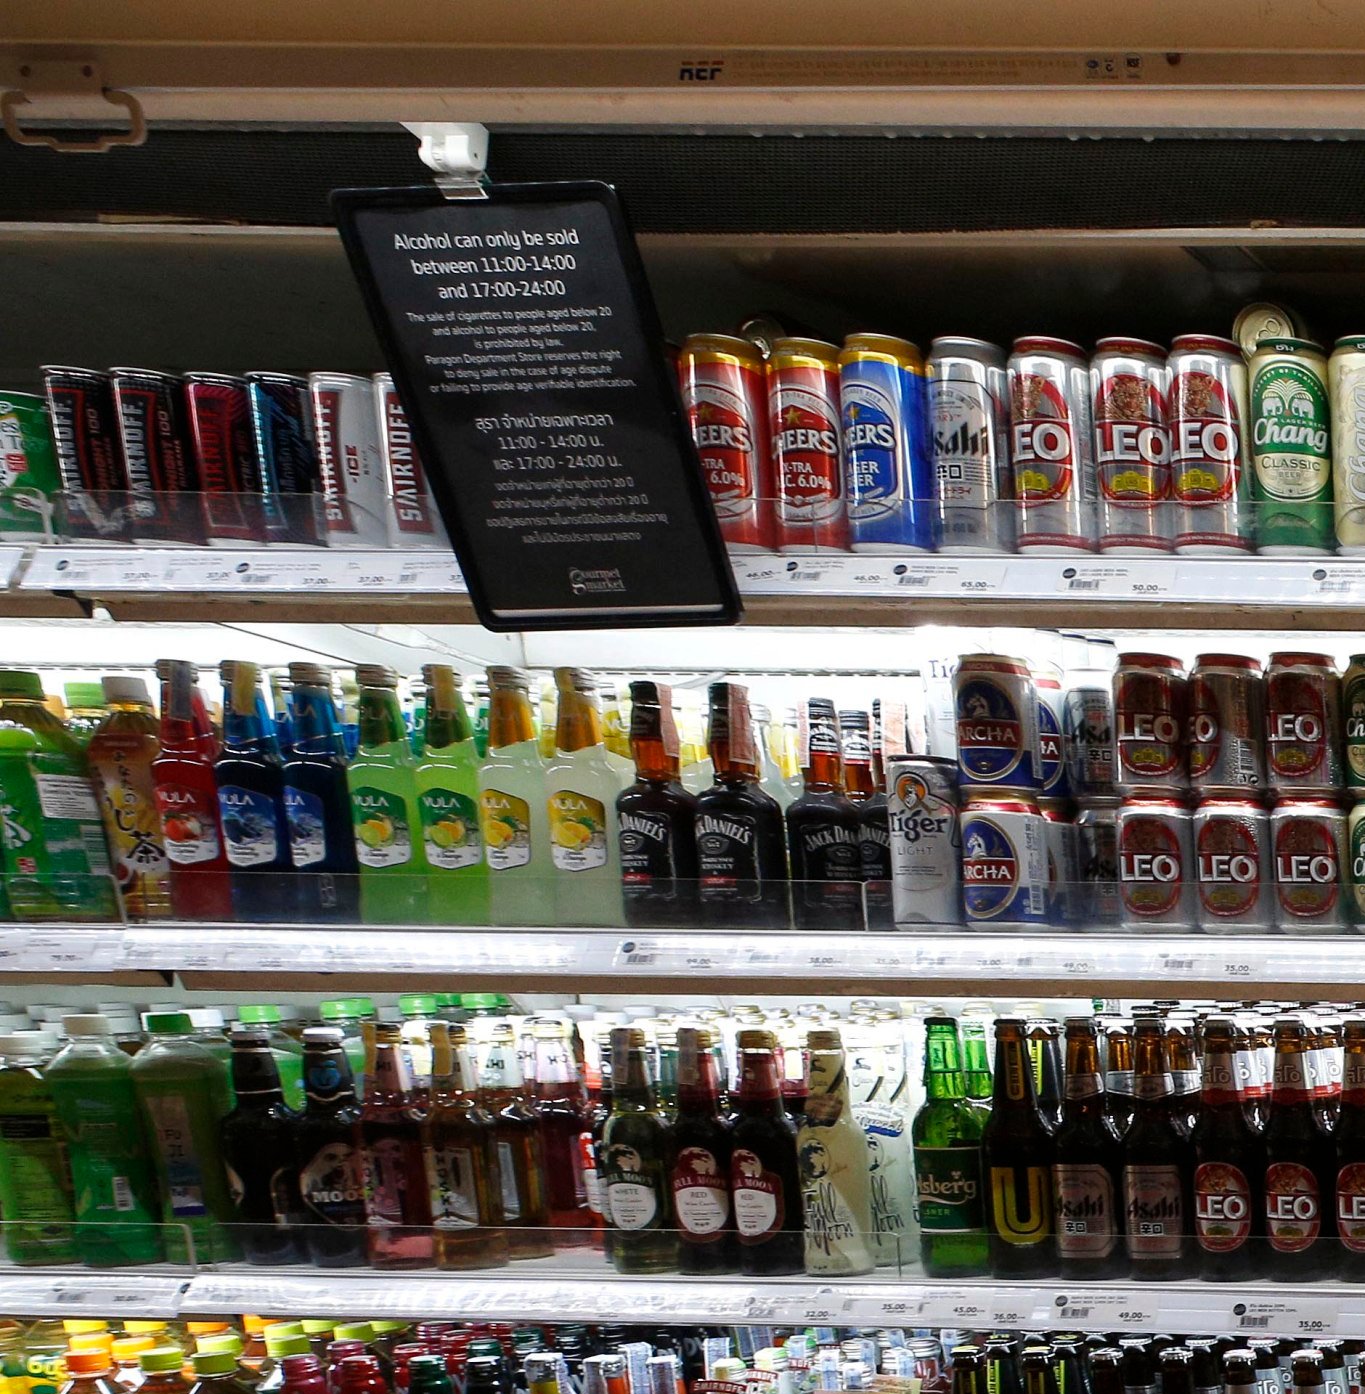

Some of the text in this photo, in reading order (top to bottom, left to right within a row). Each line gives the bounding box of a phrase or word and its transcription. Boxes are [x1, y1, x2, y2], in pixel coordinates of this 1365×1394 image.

[394, 229, 579, 250] Alcohol can only be sold
[411, 254, 576, 275] between 11:00-14:00
[438, 280, 566, 299] and 17:00-24:00
[407, 306, 612, 324] The sale of cigarettes to people aged below 20
[432, 322, 596, 336] and alcohol to people aged below 20,
[474, 338, 564, 351] is prohibited by law.
[426, 349, 622, 367] Paragon Department Store reserves the right
[444, 364, 612, 381] to deny sale in the case of age dispute
[429, 378, 637, 394] or failing to provide age verifiable identification.
[498, 436, 537, 449] 11:00
[550, 435, 587, 448] 14:00
[1173, 423, 1239, 462] LEO
[1254, 417, 1328, 452] Chang
[517, 457, 555, 469] 17:00
[567, 456, 604, 468] 24:00
[1261, 456, 1321, 472] CLASSIC
[1118, 714, 1180, 742] LEO
[897, 845, 935, 857] LIGHT
[1121, 855, 1180, 883] LEO
[1199, 855, 1258, 883] LEO
[1277, 856, 1338, 883] LEO
[1224, 965, 1250, 973] 35.00
[990, 1166, 1052, 1245] U
[1298, 1321, 1323, 1329] 35.00
